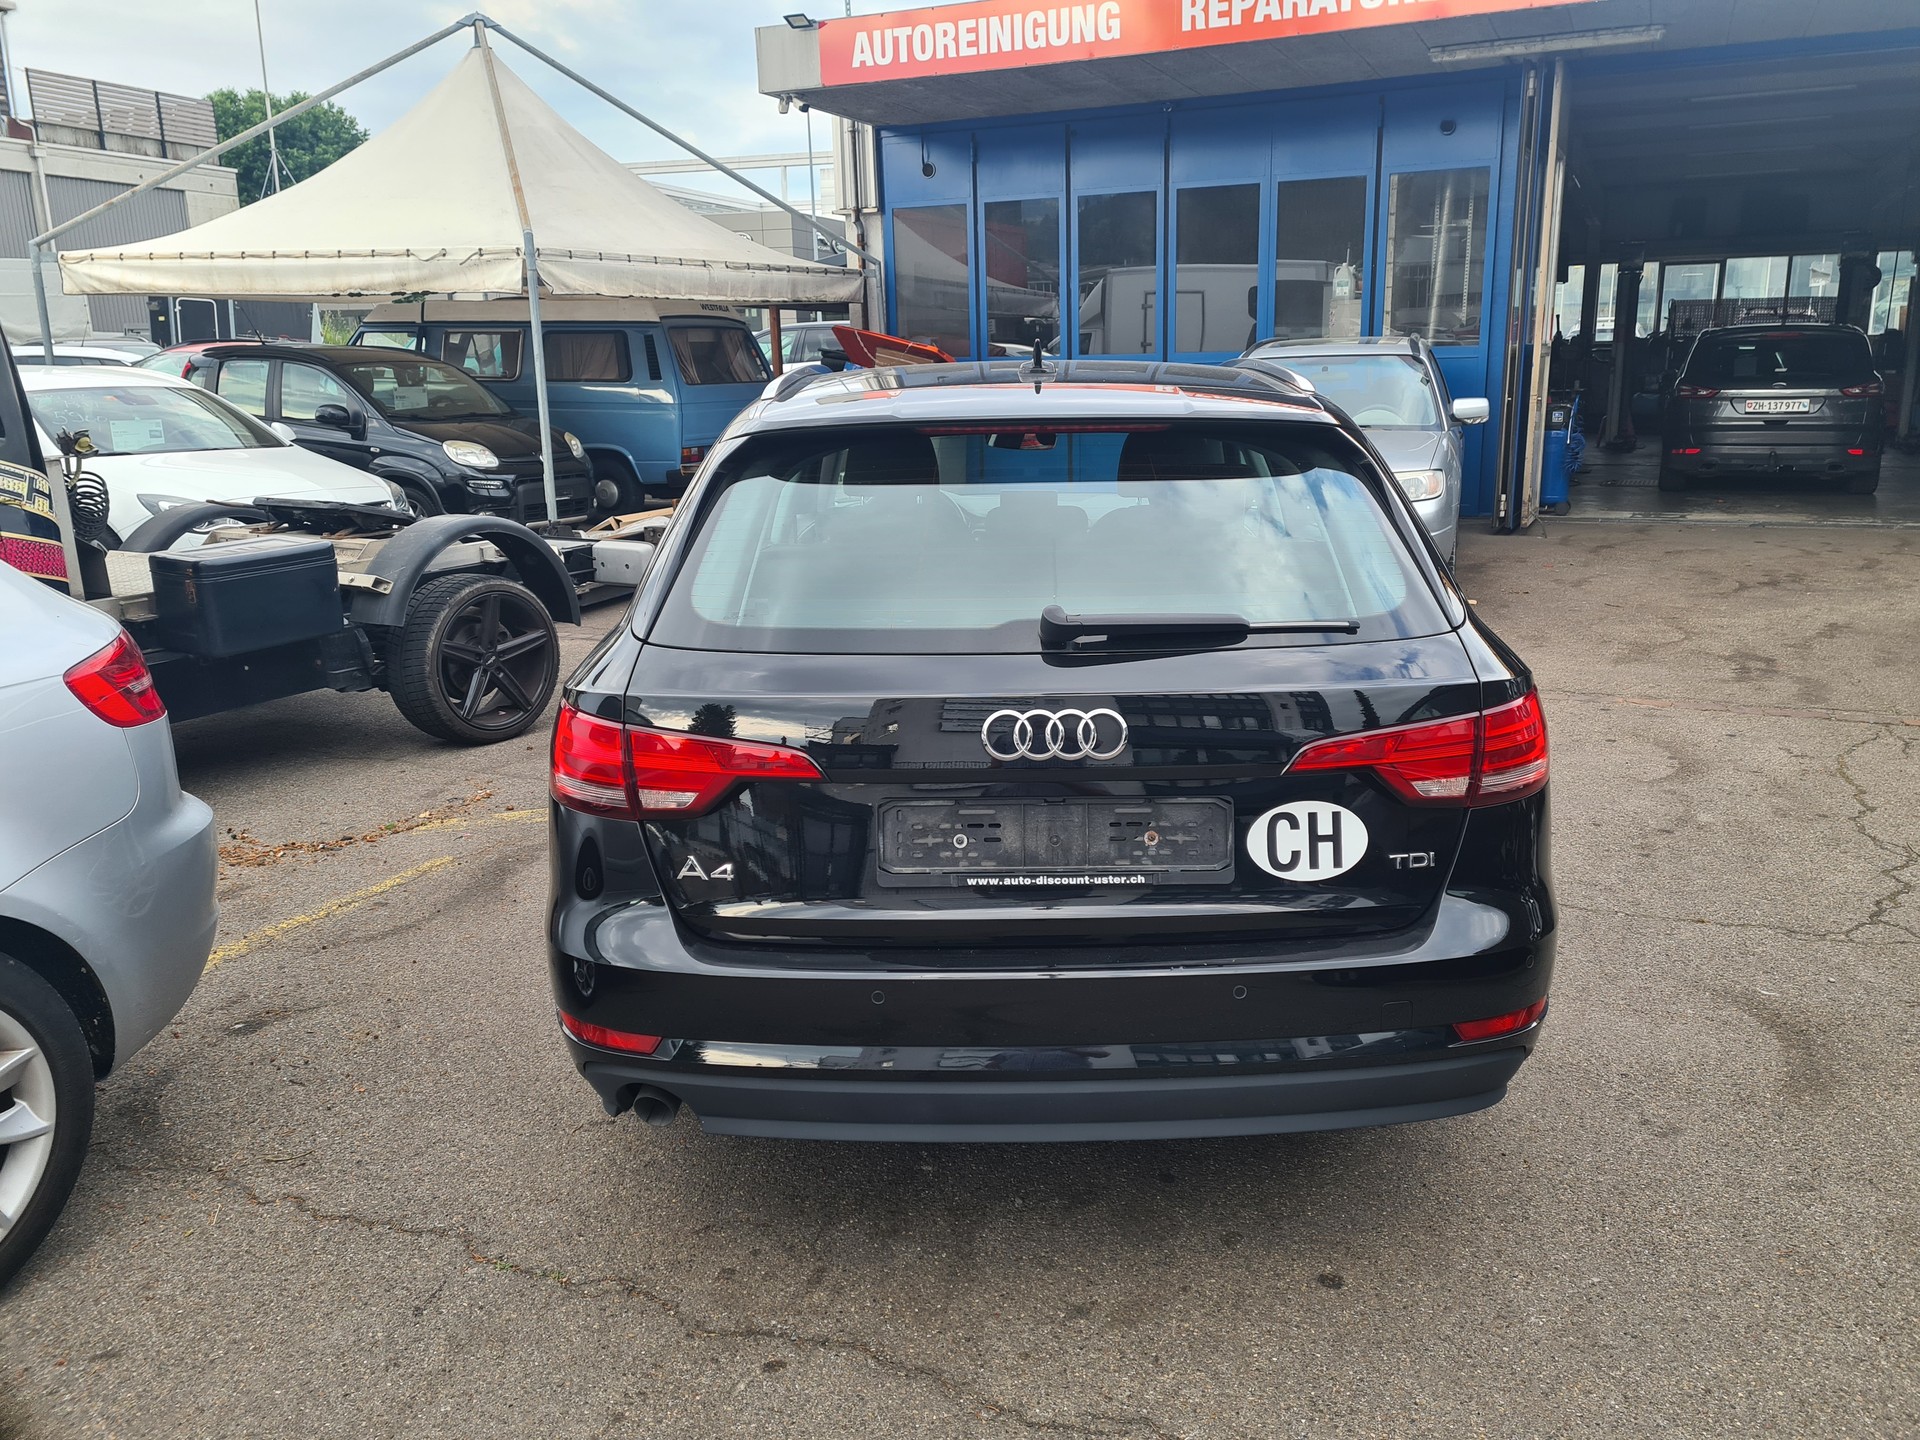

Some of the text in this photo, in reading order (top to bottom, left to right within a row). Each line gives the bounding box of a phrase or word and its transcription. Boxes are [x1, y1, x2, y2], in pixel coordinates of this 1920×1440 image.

[852, 0, 1439, 68] AUTOREINIGUNG REPAR
[1266, 811, 1344, 873] CH
[676, 855, 734, 881] A4
[1388, 851, 1435, 869] TDI
[966, 874, 1146, 886] www.auto-discount-uster.ch
